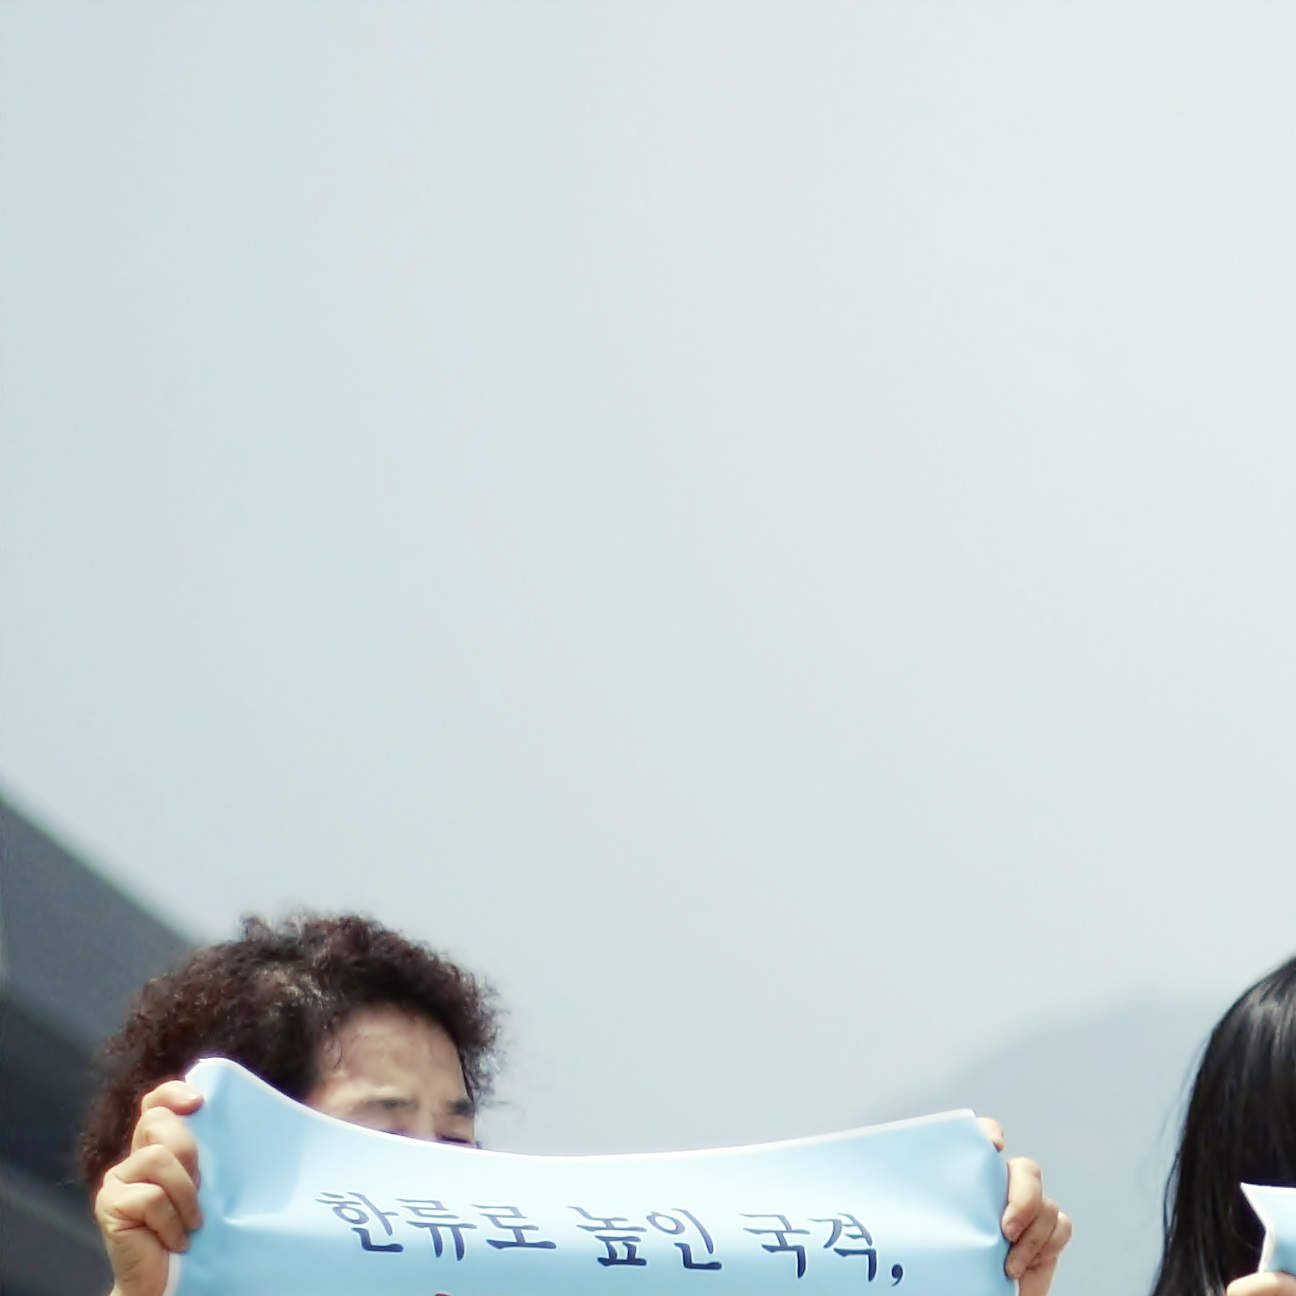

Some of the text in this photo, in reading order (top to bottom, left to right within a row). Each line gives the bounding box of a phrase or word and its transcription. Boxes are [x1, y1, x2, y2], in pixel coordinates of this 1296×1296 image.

[315, 1190, 904, 1286] 한류로 높인 국격,
